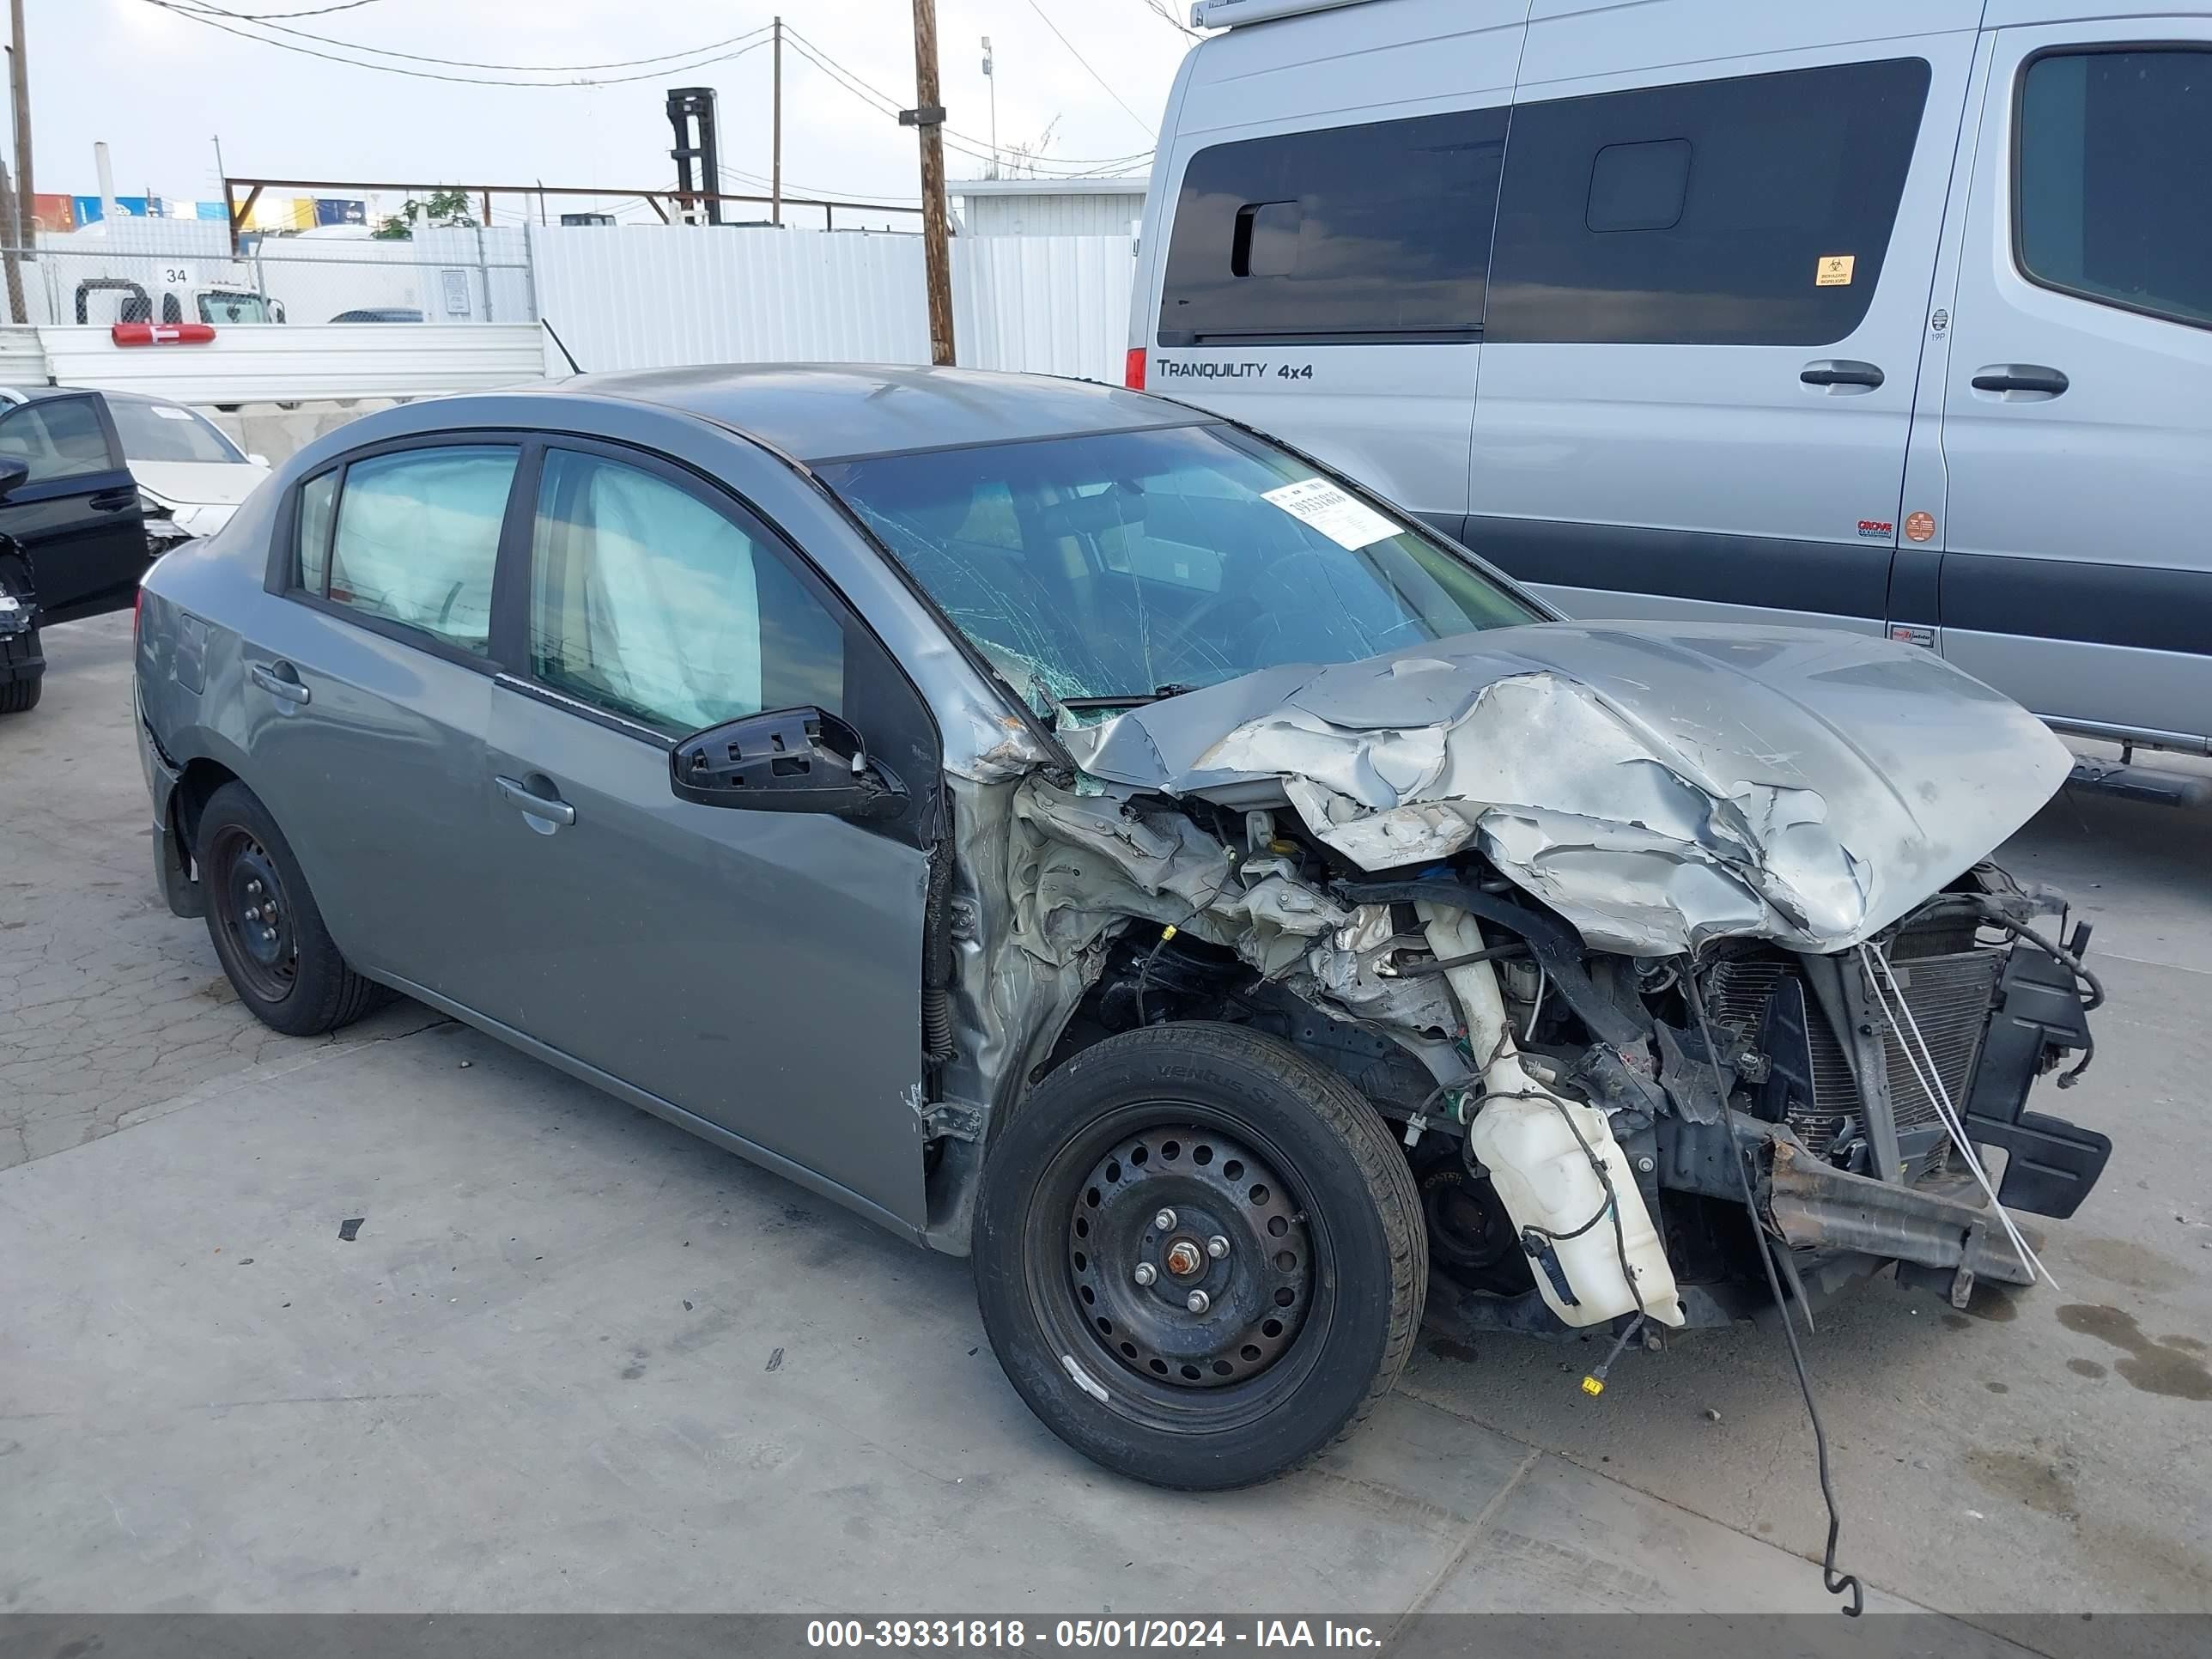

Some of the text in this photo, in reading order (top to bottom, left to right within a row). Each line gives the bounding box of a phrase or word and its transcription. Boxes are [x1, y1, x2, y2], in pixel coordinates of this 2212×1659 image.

[167, 269, 187, 283] 34
[1157, 359, 1313, 380] TRANQUILITY 4x4
[1289, 490, 1346, 515] 39331818
[1857, 520, 1893, 532] GROVE
